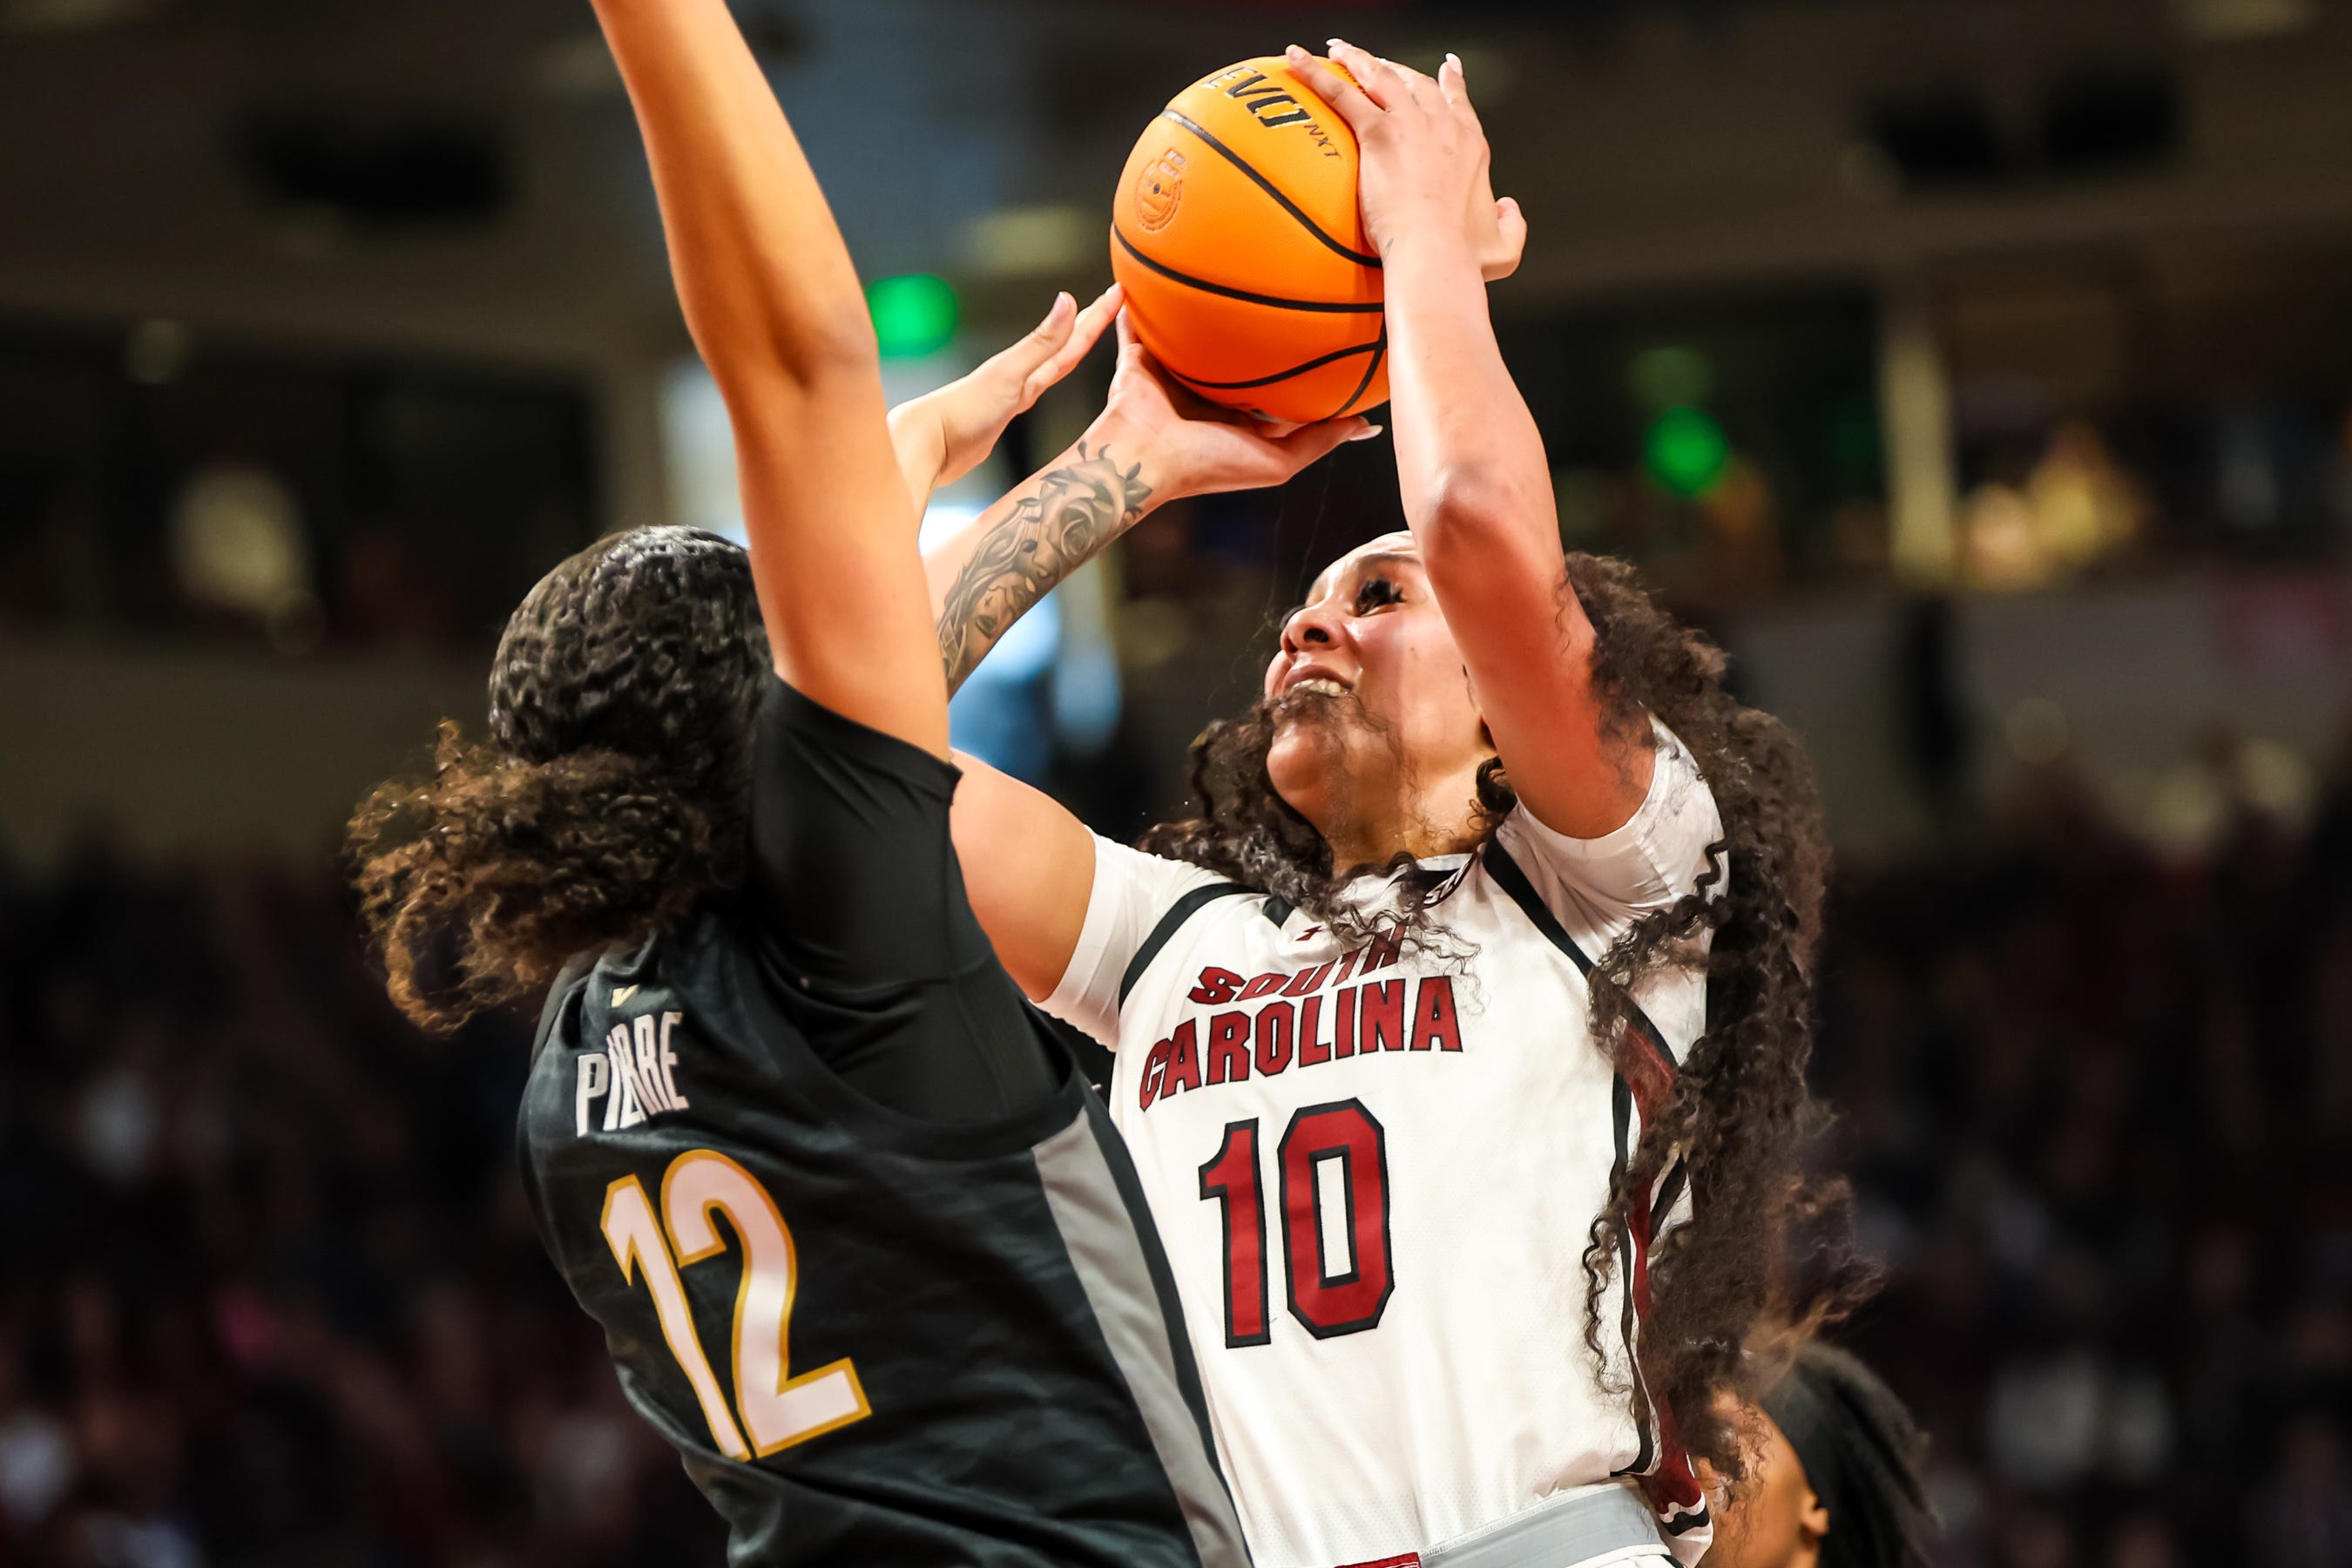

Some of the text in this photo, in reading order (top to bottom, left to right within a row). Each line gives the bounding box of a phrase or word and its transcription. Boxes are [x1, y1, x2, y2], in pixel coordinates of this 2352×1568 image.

[1202, 66, 1312, 128] EVO
[1304, 124, 1342, 159] NXT
[1187, 916, 1410, 1004] SOUTH
[1140, 976, 1463, 1112] CAROLINA
[1199, 1097, 1396, 1349] 10
[601, 1149, 872, 1462] 12
